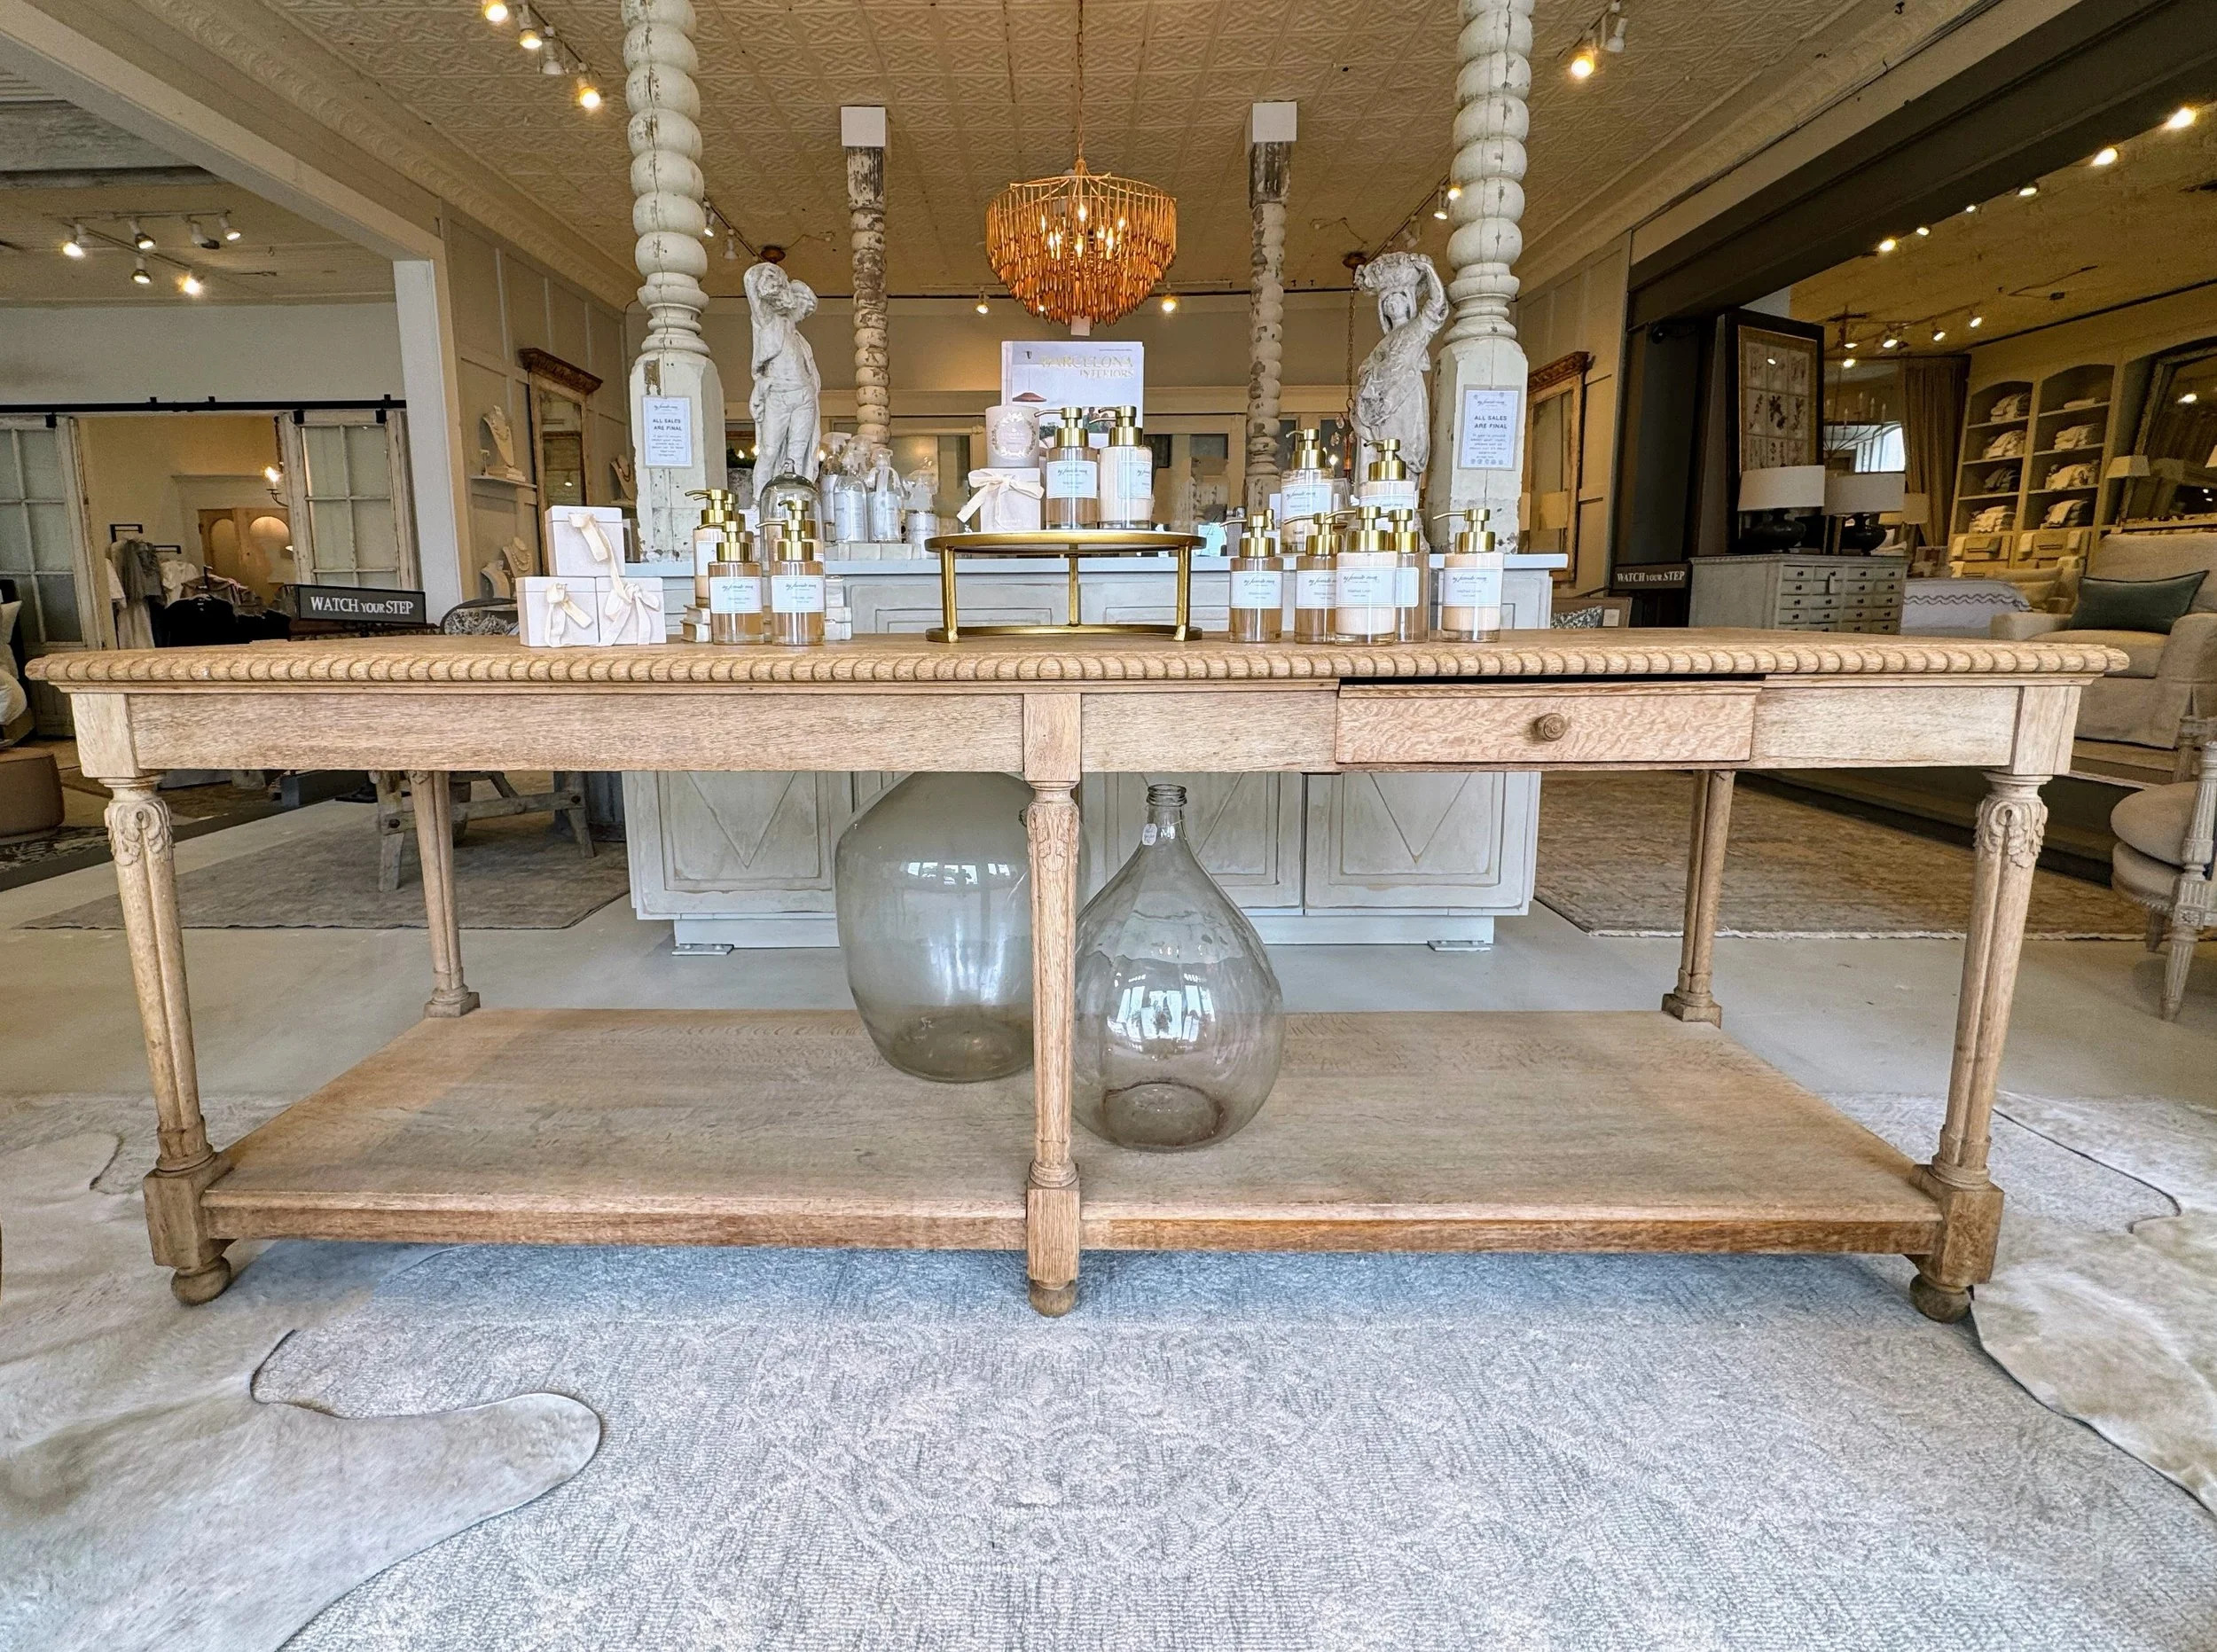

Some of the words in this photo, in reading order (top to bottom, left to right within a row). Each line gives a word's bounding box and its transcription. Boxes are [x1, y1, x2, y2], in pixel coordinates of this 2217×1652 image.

[1040, 355, 1133, 368] BARCELONA
[1080, 369, 1134, 379] INTERIORS
[1617, 572, 1647, 583] WATCH
[1663, 570, 1685, 581] STEP
[310, 596, 359, 613] WATCH
[360, 602, 386, 614] YOUR
[386, 600, 414, 615] STEP
